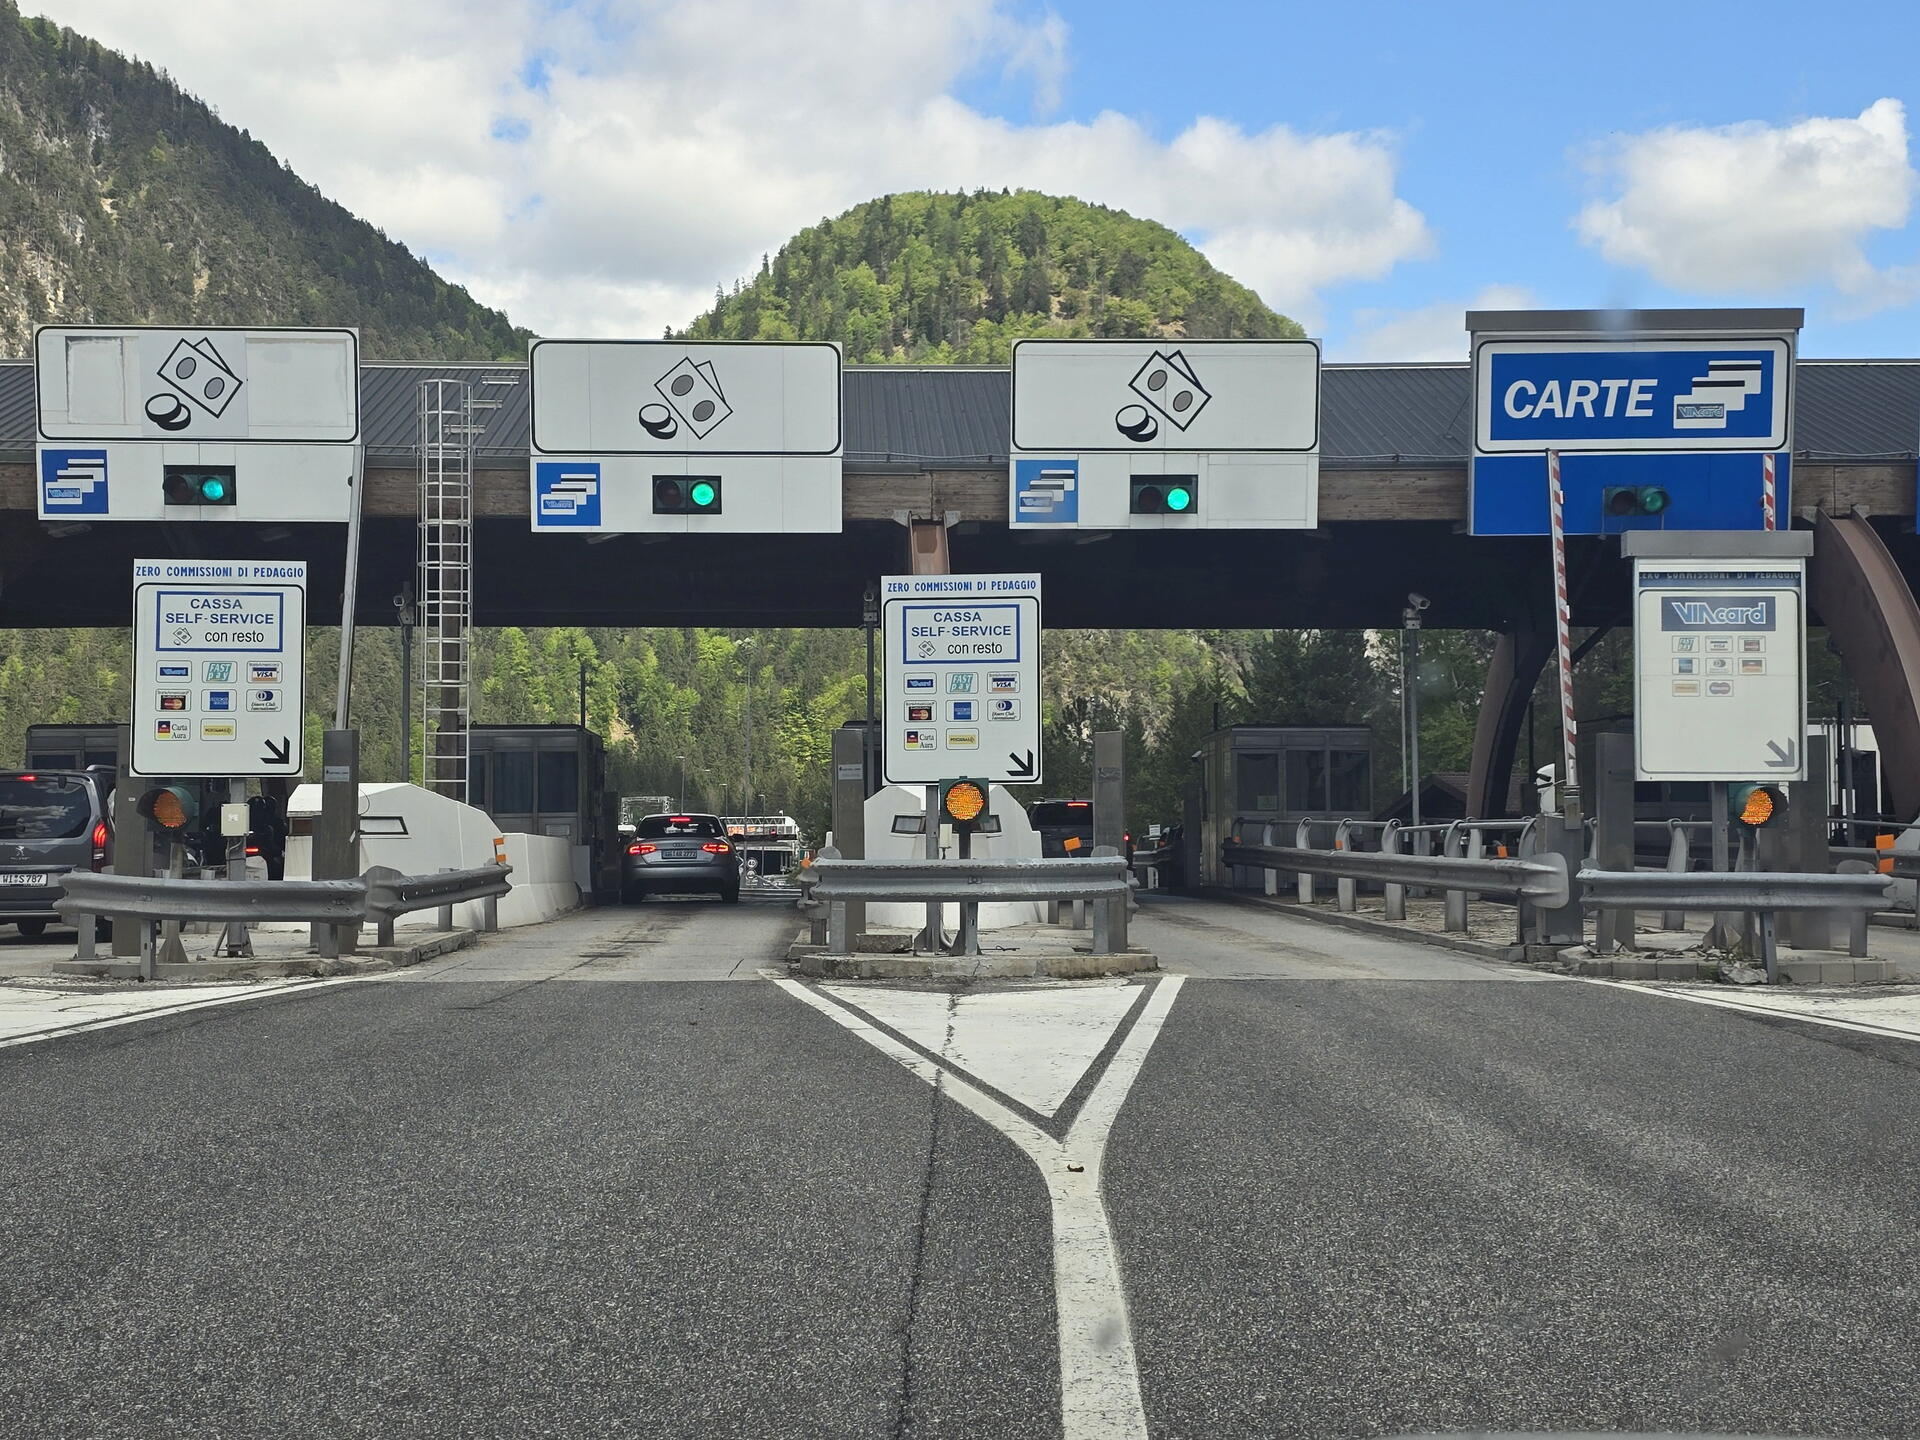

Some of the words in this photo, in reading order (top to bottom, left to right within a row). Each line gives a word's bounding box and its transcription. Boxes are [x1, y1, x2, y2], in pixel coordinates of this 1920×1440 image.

[1503, 378, 1658, 419] CARTE
[1677, 405, 1724, 418] VIAcard
[135, 566, 161, 577] ZERO
[166, 566, 232, 577] COMMISSIONI
[237, 566, 249, 577] DI
[253, 566, 304, 578] PEDAGGIO
[887, 582, 910, 593] ZERO
[914, 581, 973, 592] COMMISSIONI
[977, 581, 987, 591] DI
[991, 580, 1036, 591] PEDAGGIO
[190, 598, 243, 609] CASSA
[165, 612, 275, 624] SELF-SERVICE
[933, 612, 982, 623] CASSA
[1671, 601, 1767, 625] VIAcard
[204, 632, 229, 643] con
[231, 630, 265, 643] resto
[911, 625, 1012, 637] SELF-SERVICE
[947, 643, 970, 654] con
[972, 641, 1003, 654] resto
[209, 663, 230, 672] FAST
[207, 673, 228, 682] pay
[953, 674, 972, 683] FAST
[951, 684, 970, 692] pay
[171, 724, 188, 732] Carta
[919, 733, 935, 741] Carta
[2, 874, 12, 883] WI
[18, 874, 25, 884] S
[26, 874, 42, 883] 787
